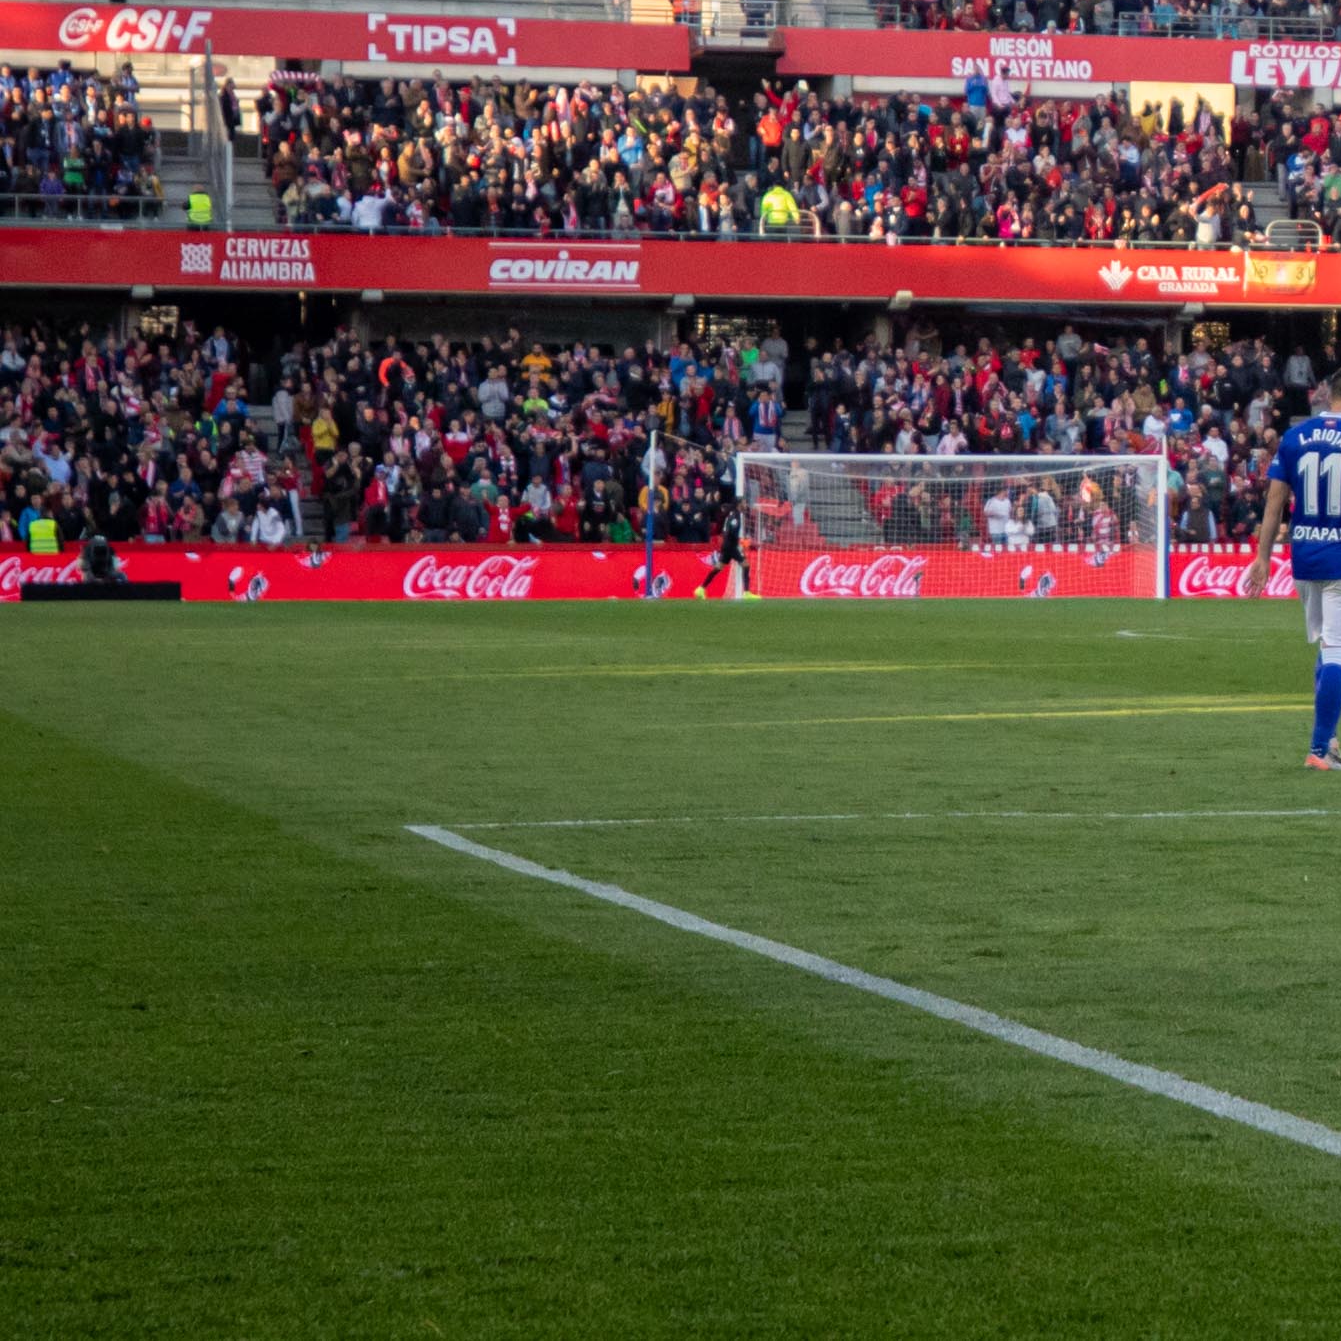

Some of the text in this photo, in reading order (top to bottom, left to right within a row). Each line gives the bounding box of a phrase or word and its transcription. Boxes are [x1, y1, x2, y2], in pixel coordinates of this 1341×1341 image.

[387, 24, 497, 55] TIPSA
[990, 36, 1052, 57] MESÓN
[1249, 41, 1341, 59] RÓTULOS
[952, 57, 1092, 79] SAN CAYETANO
[226, 238, 310, 258] CERVEZAS
[220, 260, 315, 281] ALHAMBRA
[1137, 266, 1239, 282] CAJA RURAL
[1158, 282, 1218, 293] GRANADA
[403, 555, 540, 597] Coca-Cola
[800, 555, 928, 596] Coca-Cola
